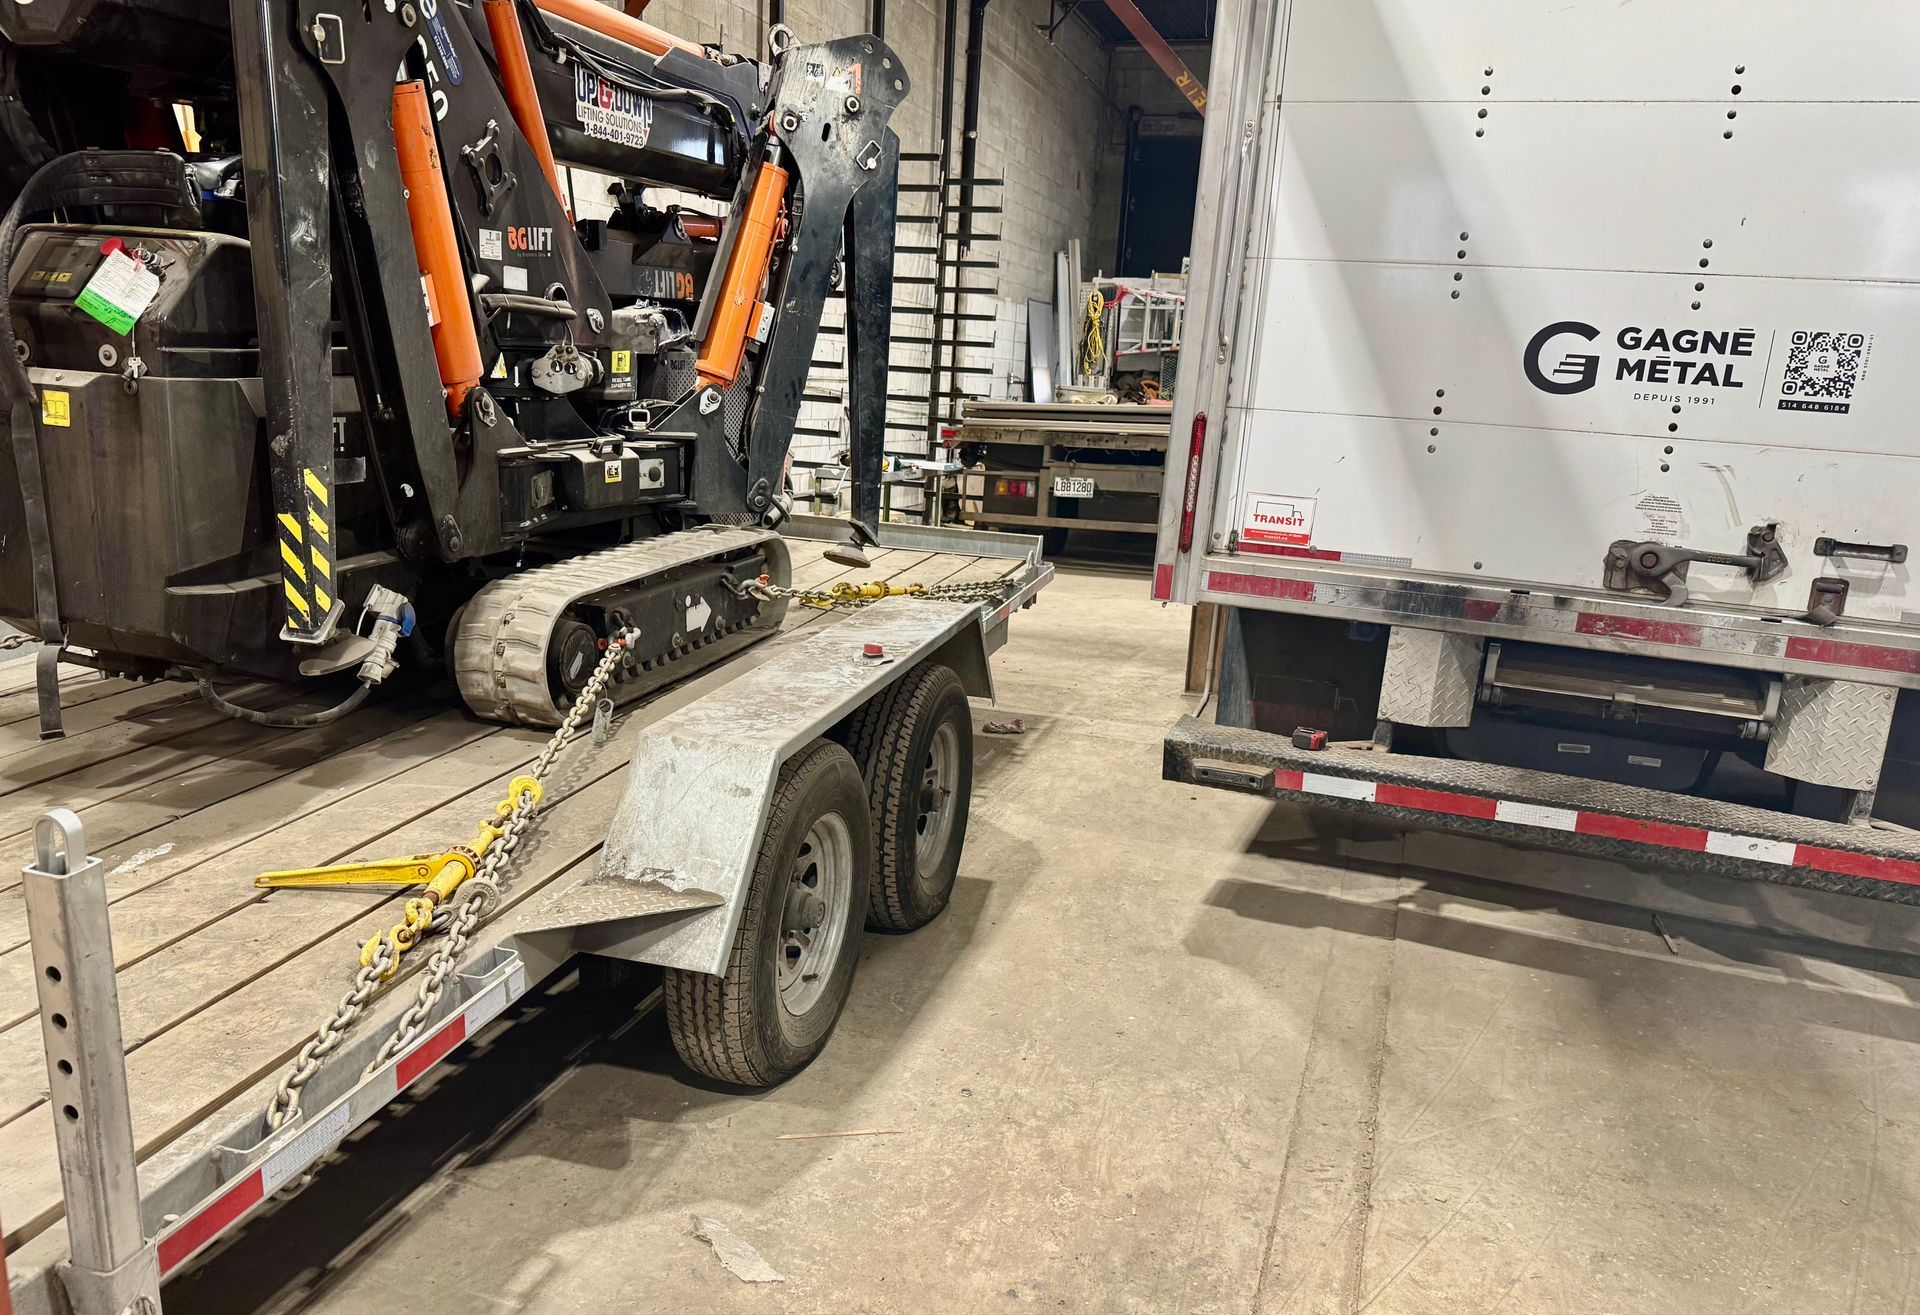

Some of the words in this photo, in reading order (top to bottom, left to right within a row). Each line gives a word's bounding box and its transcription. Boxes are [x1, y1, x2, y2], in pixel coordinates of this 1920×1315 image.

[577, 105, 605, 124] LIFTING
[605, 112, 643, 134] SOLUTIONS
[1633, 392, 1682, 404] DEPUIS
[1687, 396, 1716, 406] 1991
[1801, 402, 1820, 410] 648
[1253, 513, 1305, 527] TRANSIT
